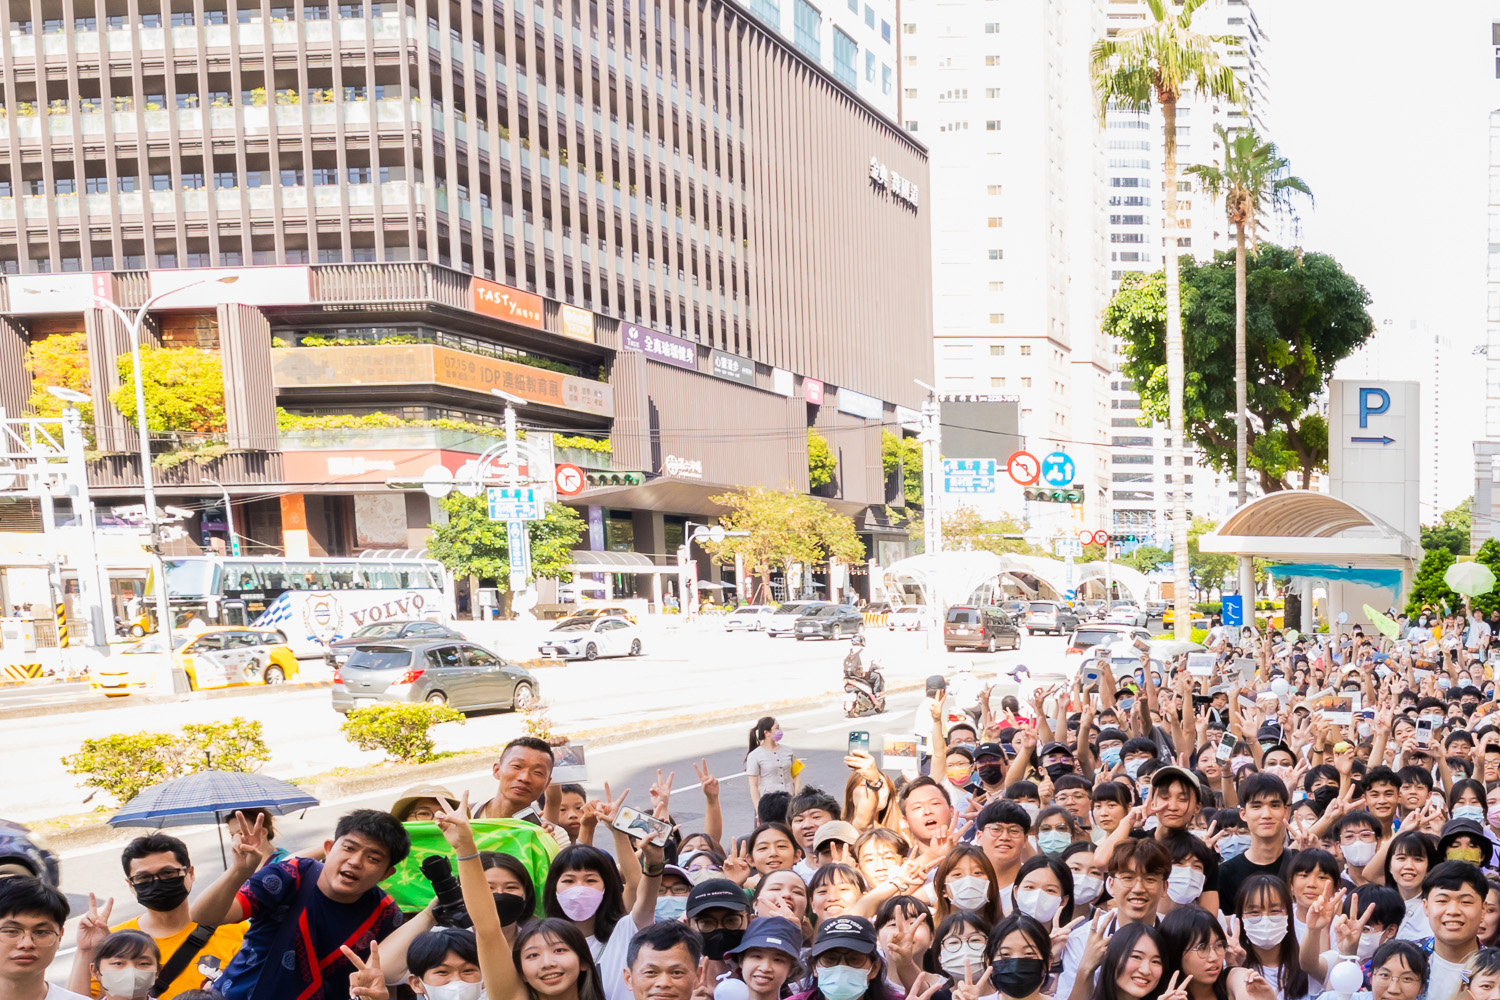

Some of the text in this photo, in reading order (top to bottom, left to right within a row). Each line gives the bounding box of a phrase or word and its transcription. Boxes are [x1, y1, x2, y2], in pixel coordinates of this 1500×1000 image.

[477, 287, 517, 315] TASTY
[481, 366, 500, 384] IDP
[1358, 387, 1391, 429] P
[350, 594, 425, 626] VOLVO
